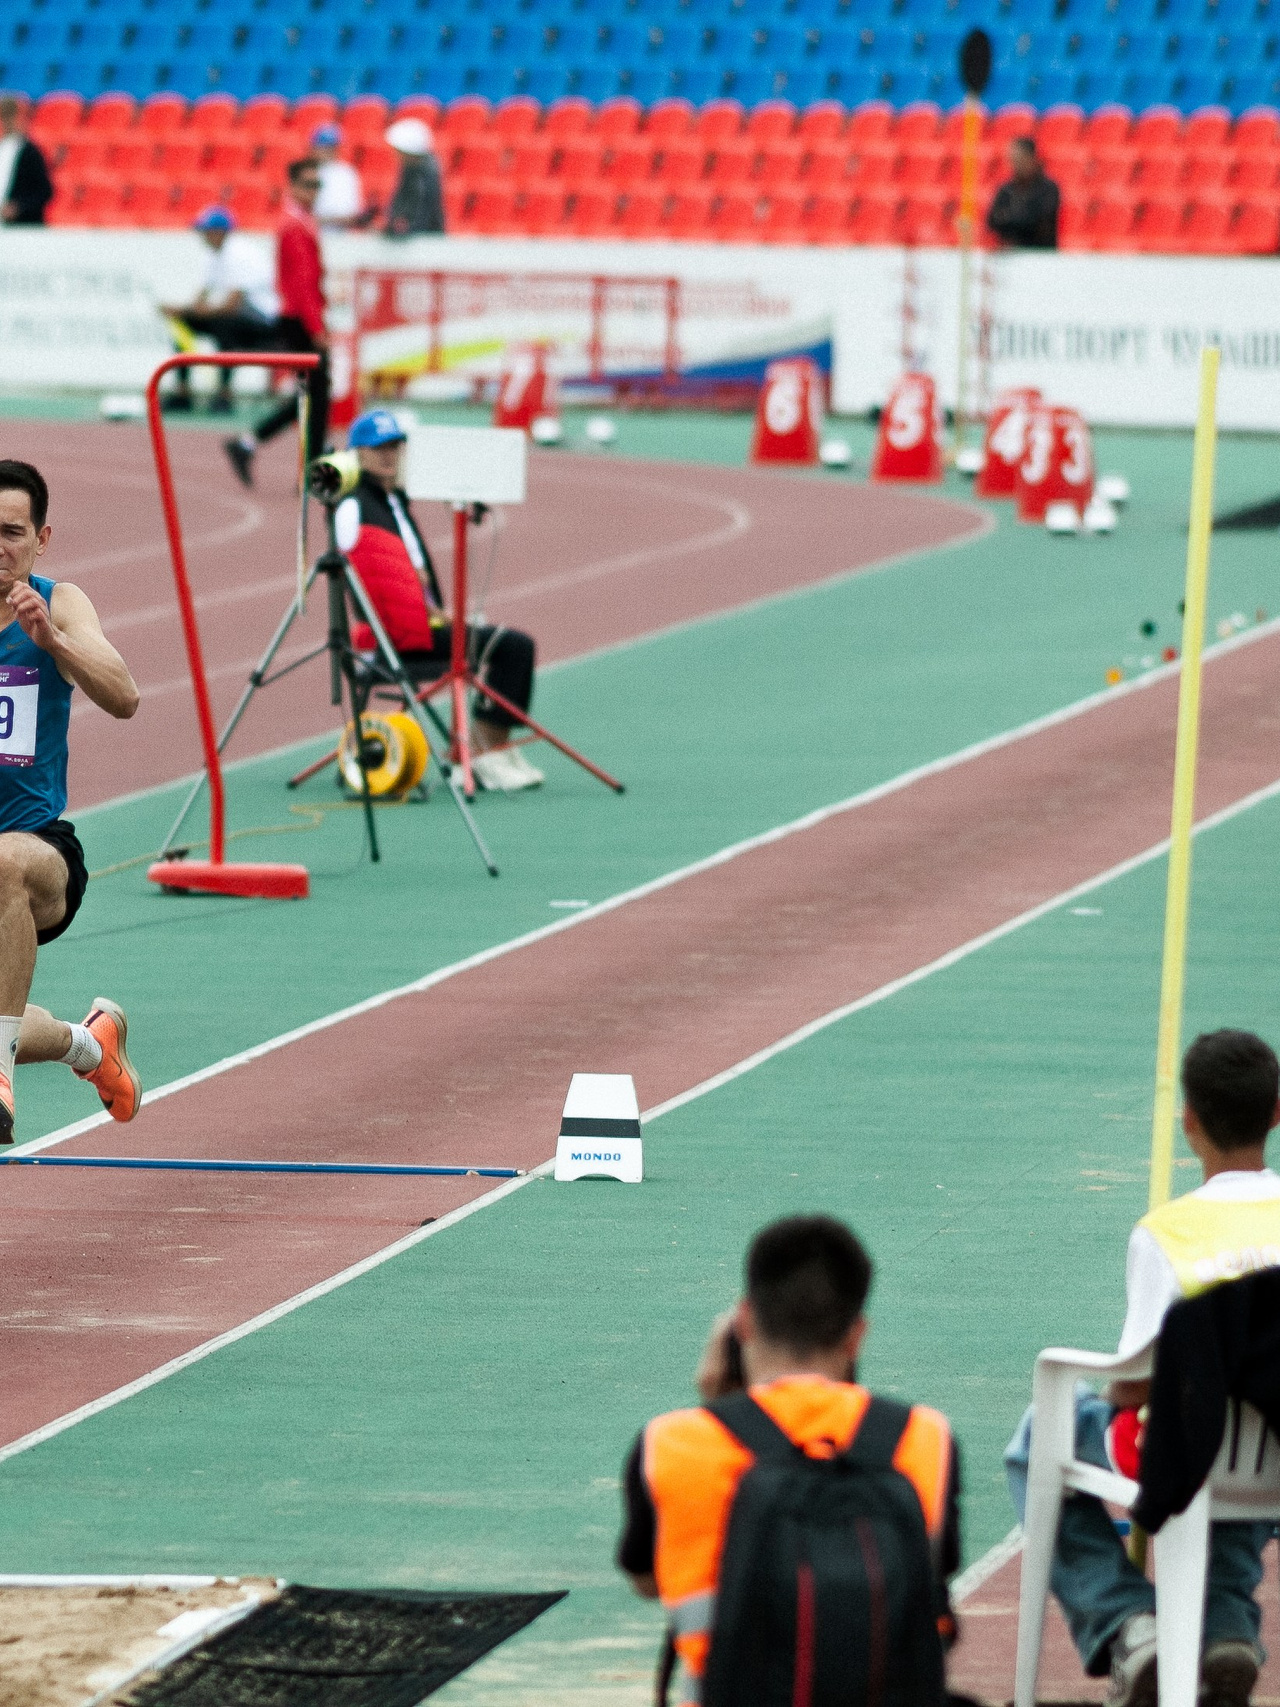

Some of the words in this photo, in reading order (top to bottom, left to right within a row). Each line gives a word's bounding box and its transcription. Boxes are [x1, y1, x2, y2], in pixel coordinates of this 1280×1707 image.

[765, 369, 801, 434] 6
[887, 385, 927, 449] 5
[571, 1152, 622, 1161] MONDO
